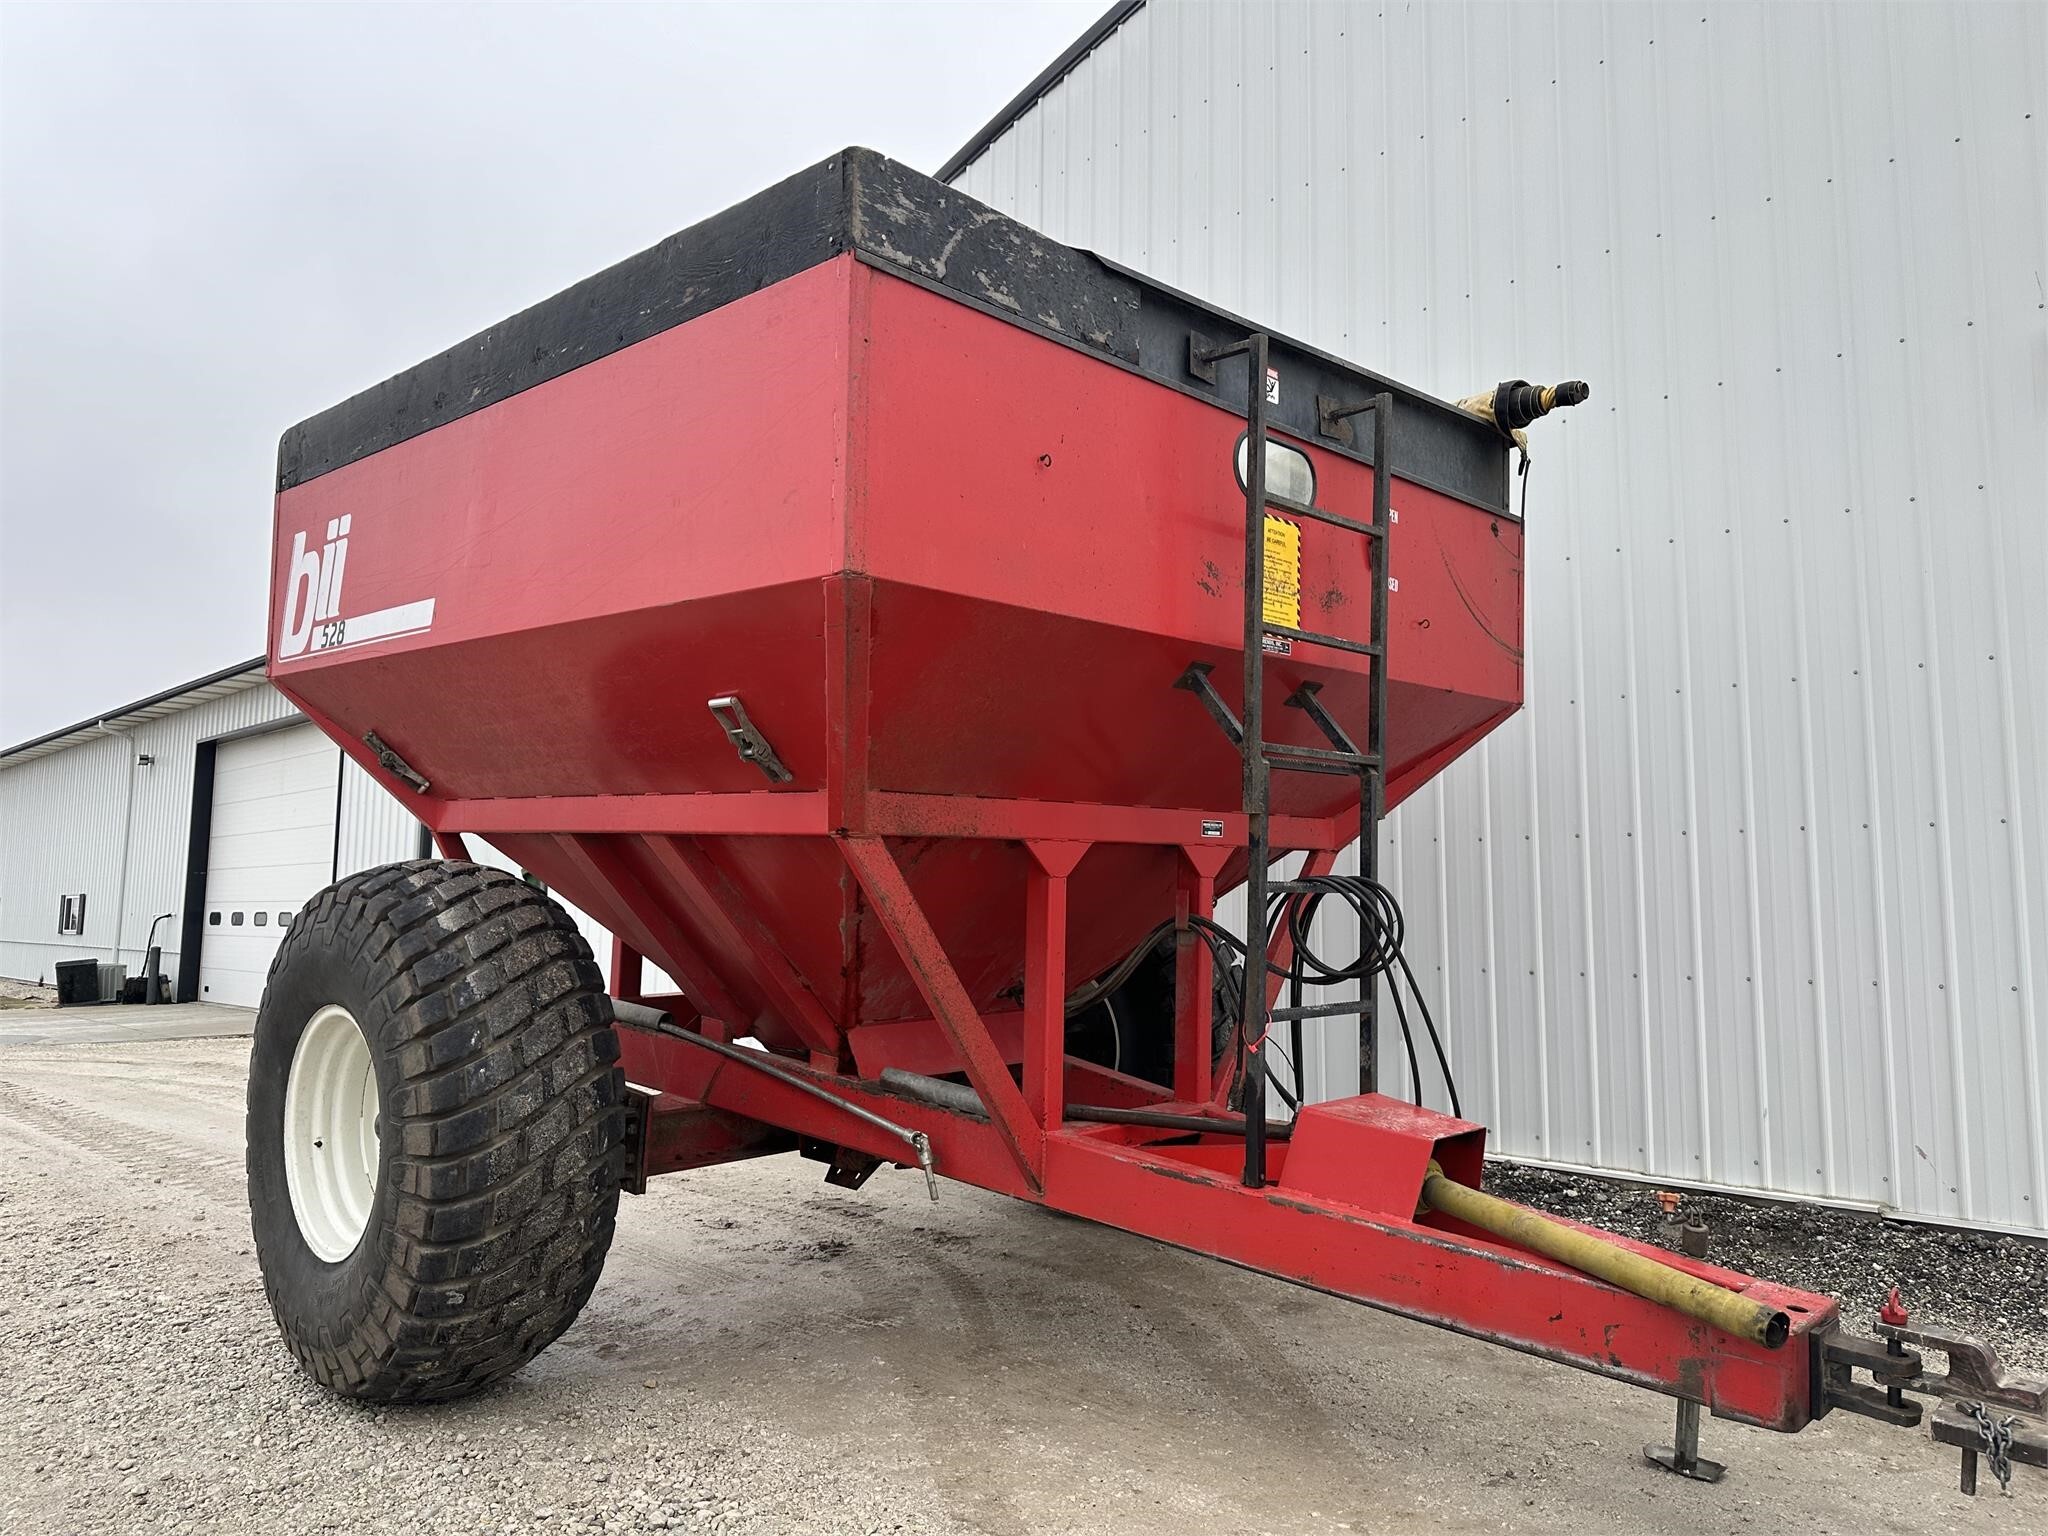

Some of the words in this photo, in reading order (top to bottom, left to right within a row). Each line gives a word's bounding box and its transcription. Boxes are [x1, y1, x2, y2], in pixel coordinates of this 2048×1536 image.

[1389, 508, 1398, 524] PEN
[1268, 528, 1285, 537] ATTENTION
[320, 620, 346, 648] 528
